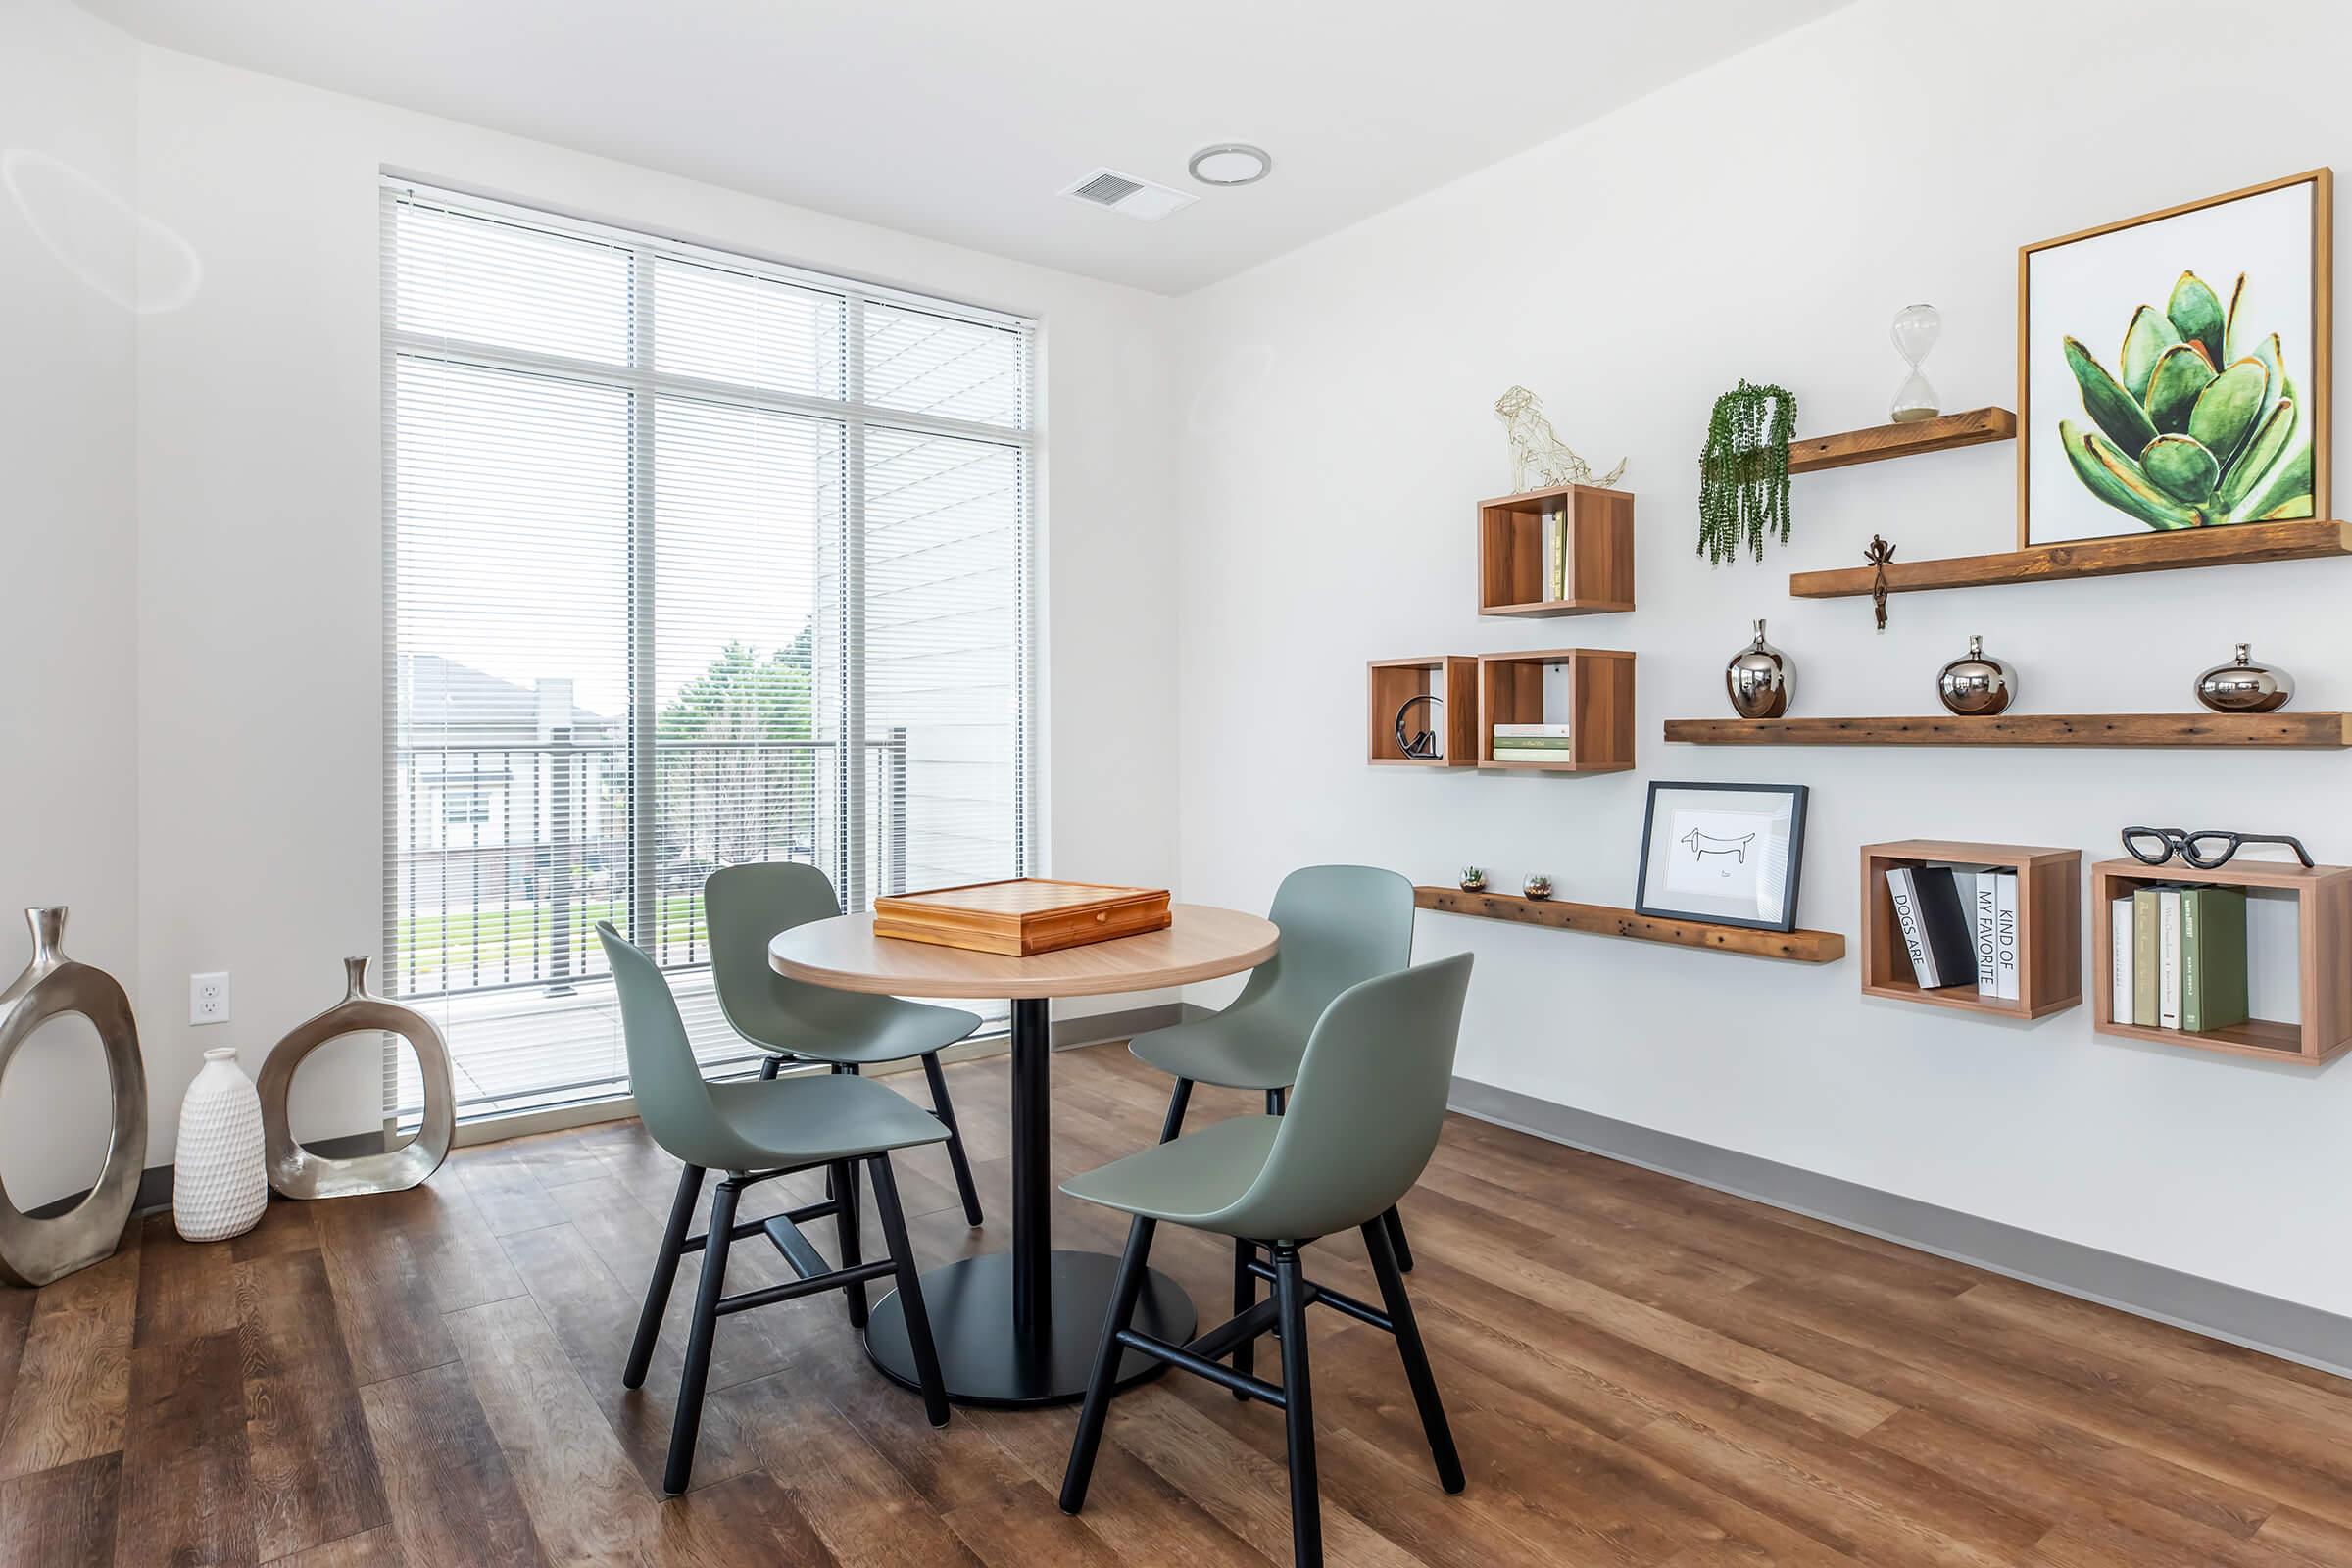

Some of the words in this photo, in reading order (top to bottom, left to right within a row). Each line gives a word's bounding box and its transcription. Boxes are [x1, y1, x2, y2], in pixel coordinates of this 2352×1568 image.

[1979, 890, 1992, 914] MY
[1894, 894, 1916, 935] DOGS
[1907, 939, 1924, 965] ARE
[1999, 909, 2014, 946] KIND
[1979, 917, 1994, 985] FAVORITE
[1999, 950, 2014, 970] OF
